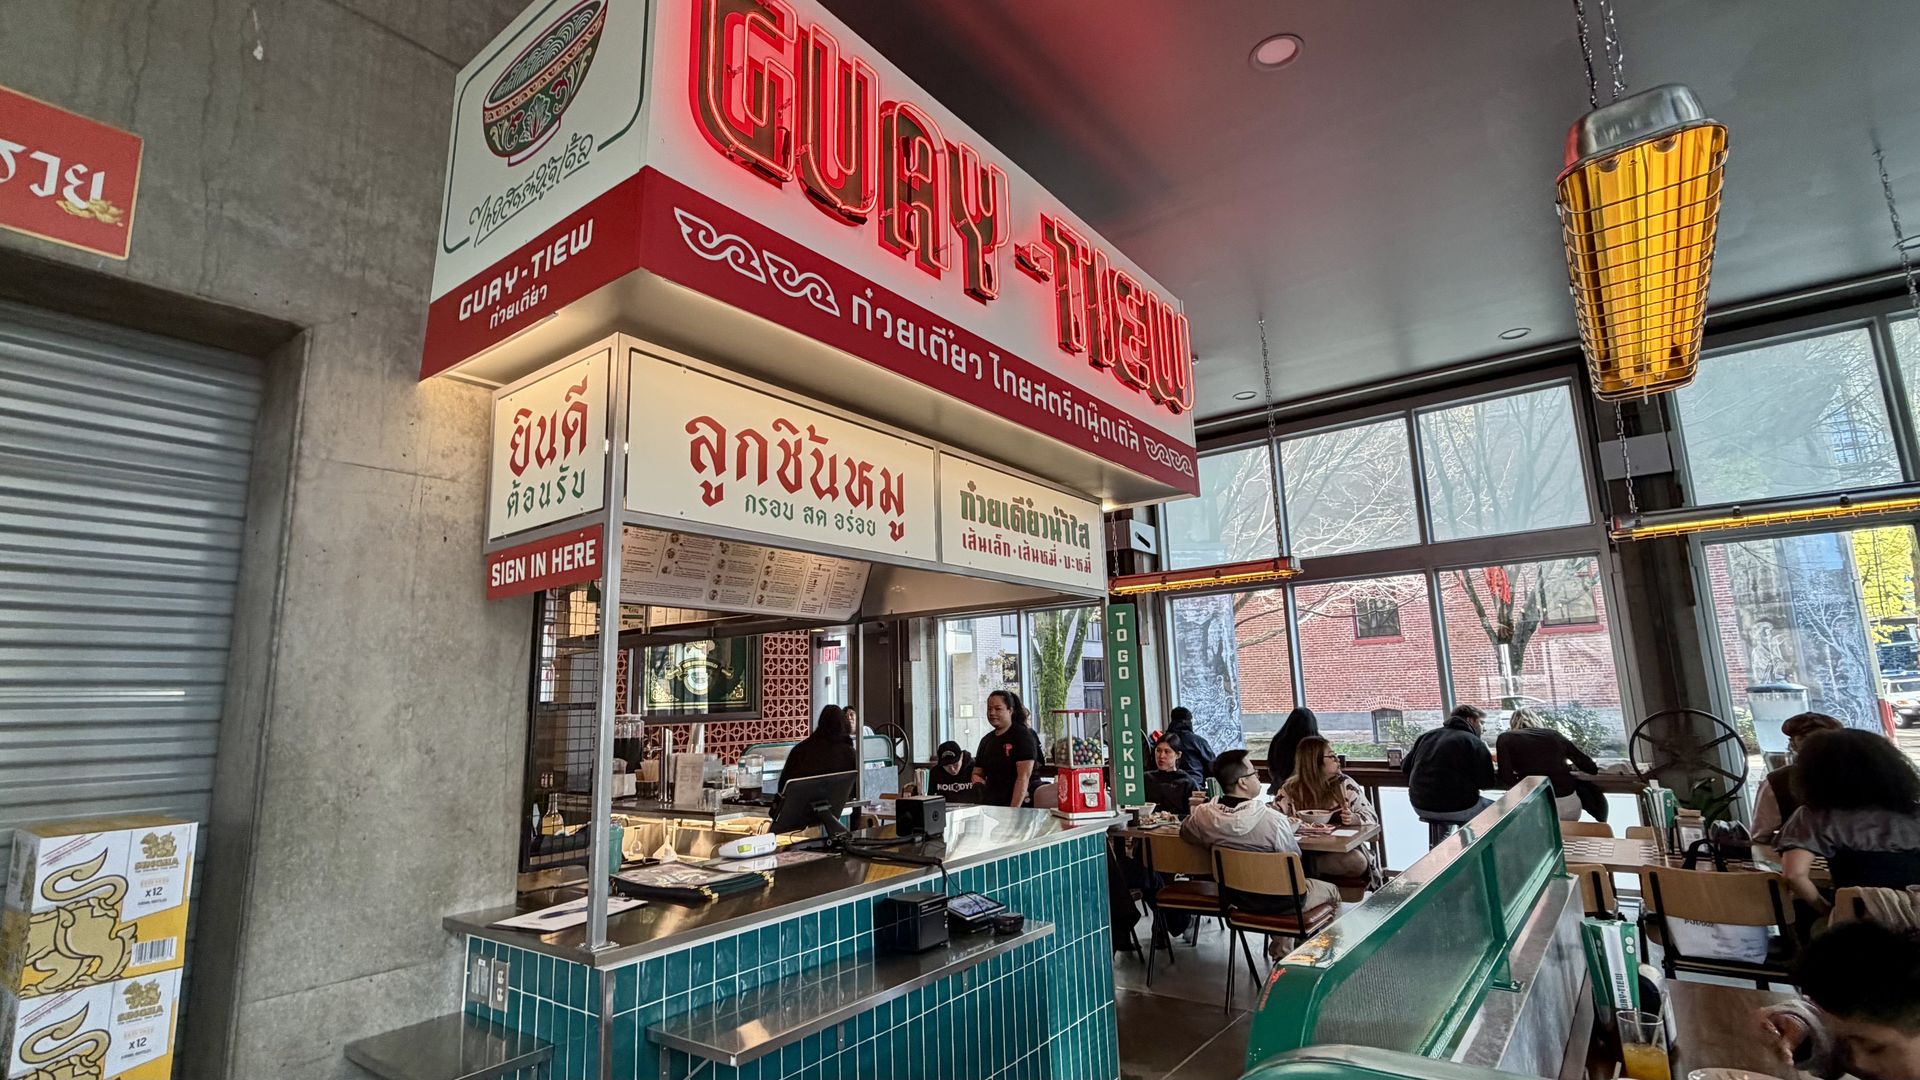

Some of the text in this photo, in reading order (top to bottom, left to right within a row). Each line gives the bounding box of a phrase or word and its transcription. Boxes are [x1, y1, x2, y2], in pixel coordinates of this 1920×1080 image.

[690, 0, 1194, 415] GUAY-TIEW
[459, 219, 594, 321] GUAY-TIEW
[852, 287, 983, 380] ก๋วยเตี๋ยว
[509, 374, 589, 477] ยินดี
[507, 463, 586, 519] ต้อนรับ
[685, 415, 905, 542] ลูกชิ้นหมู
[744, 494, 876, 537] กรอบ สด อร่อย
[491, 556, 526, 588] SIGN
[530, 551, 547, 579] IN
[552, 539, 597, 574] HERE
[1119, 696, 1137, 797] PICKUP
